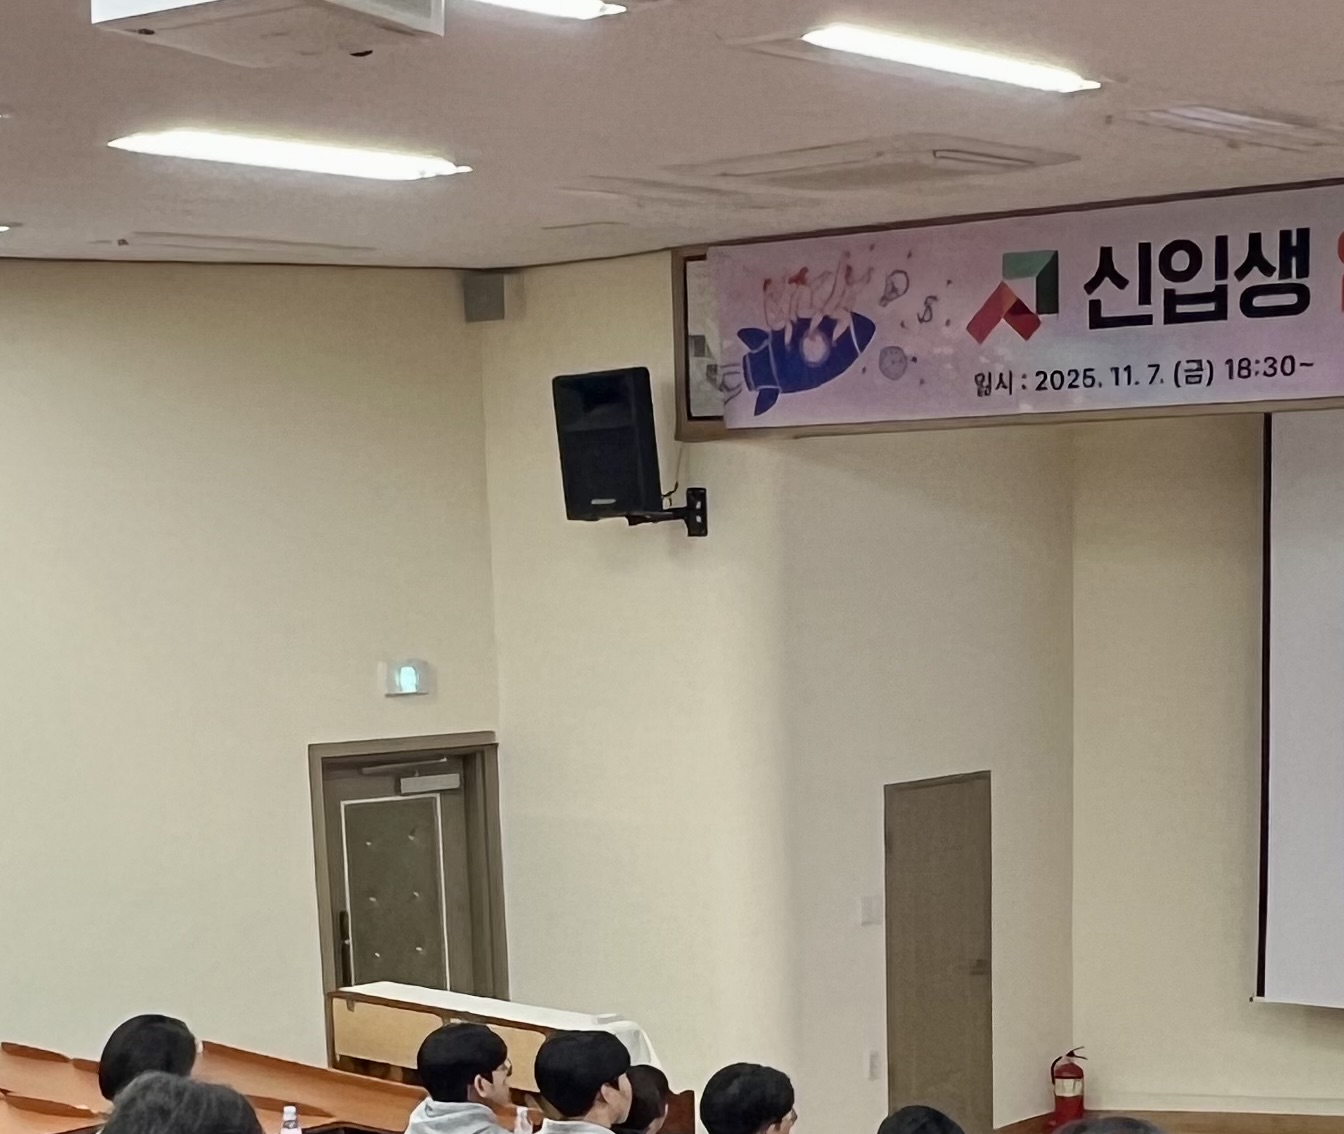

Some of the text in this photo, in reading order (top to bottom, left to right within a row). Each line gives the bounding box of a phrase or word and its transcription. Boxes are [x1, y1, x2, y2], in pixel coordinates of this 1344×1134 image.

[1083, 227, 1312, 331] 신입생
[1035, 367, 1103, 392] 2025.
[1110, 364, 1141, 387] 11.
[1146, 363, 1165, 386] 7.
[1173, 359, 1216, 389] (금)
[1224, 354, 1316, 381] 18:30~
